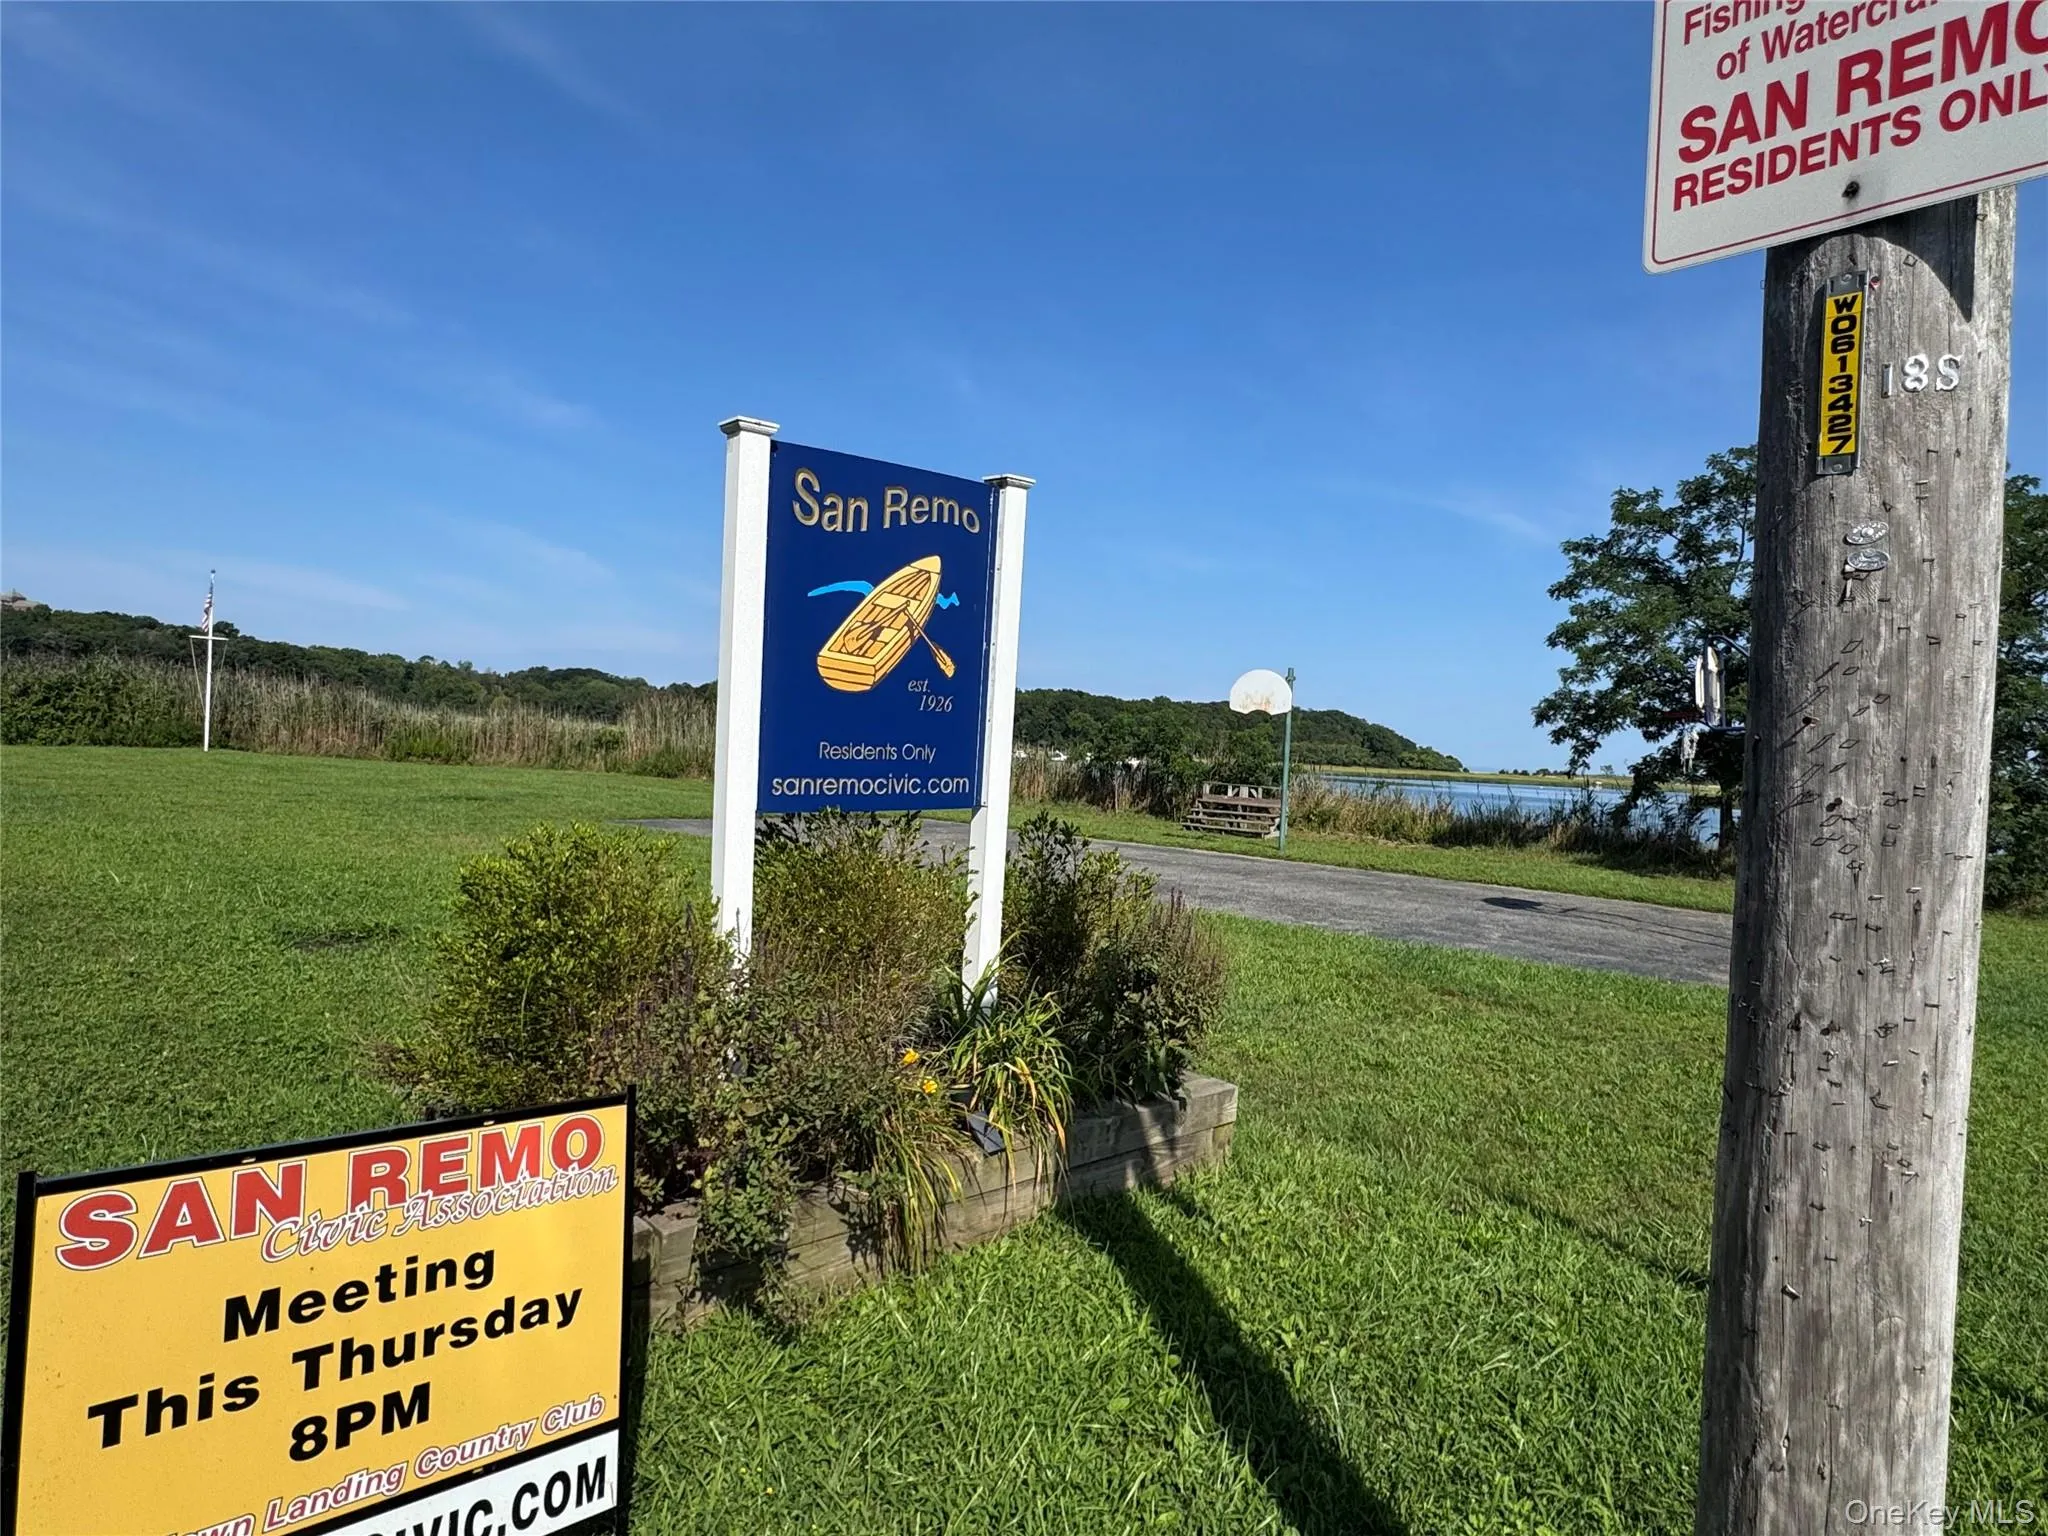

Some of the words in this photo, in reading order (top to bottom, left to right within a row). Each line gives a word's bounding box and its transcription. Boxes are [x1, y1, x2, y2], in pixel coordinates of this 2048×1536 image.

[1716, 37, 1750, 80] of
[1673, 104, 1922, 212] RESIDENTS
[1938, 63, 2048, 132] ONL
[1678, 71, 1809, 164] SAN
[793, 467, 869, 533] San
[883, 486, 980, 534] Remo
[908, 679, 931, 693] est.
[919, 694, 953, 713] 1926
[771, 773, 969, 796] sanremocivic.com
[819, 742, 897, 761] Residents
[901, 744, 936, 764] Only
[56, 1160, 306, 1271] SAN
[348, 1114, 605, 1213] REMO
[262, 1201, 388, 1264] Civic
[393, 1163, 619, 1236] Association
[223, 1249, 496, 1342] Meeting
[87, 1373, 261, 1449] This
[291, 1288, 583, 1391] Thursday
[261, 1460, 409, 1531] Landing
[414, 1418, 537, 1479] Country
[541, 1393, 606, 1434] Club
[289, 1382, 430, 1462] 8PM
